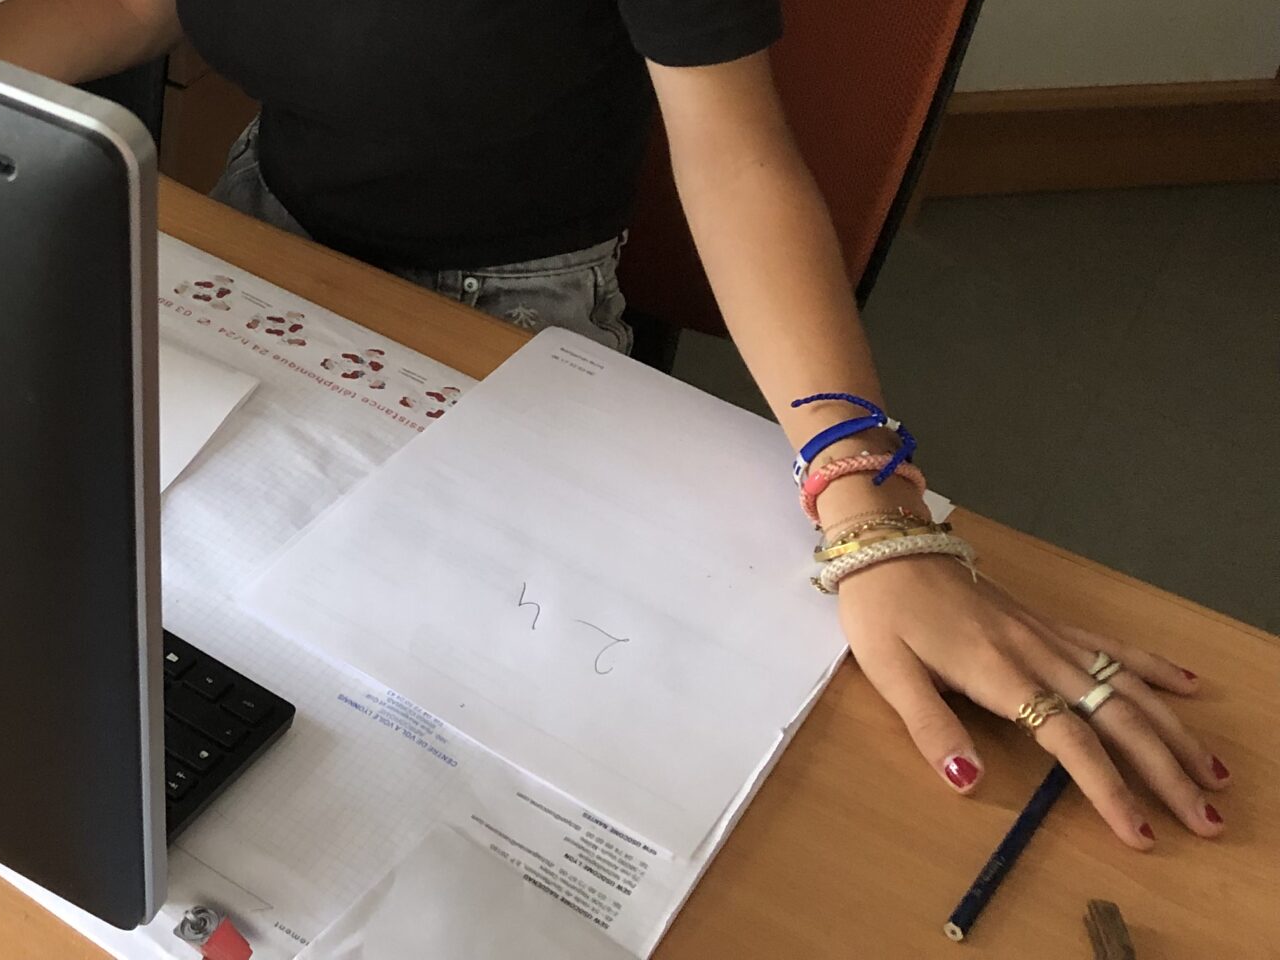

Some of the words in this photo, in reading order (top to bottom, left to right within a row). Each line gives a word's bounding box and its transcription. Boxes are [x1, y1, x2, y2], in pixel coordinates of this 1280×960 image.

[250, 342, 269, 357] 24
[359, 394, 426, 434] ssistance
[372, 712, 394, 729] VOILE
[400, 728, 416, 741] VOL
[415, 738, 428, 749] DE
[427, 746, 458, 767] CENTRE
[563, 853, 582, 866] LYON
